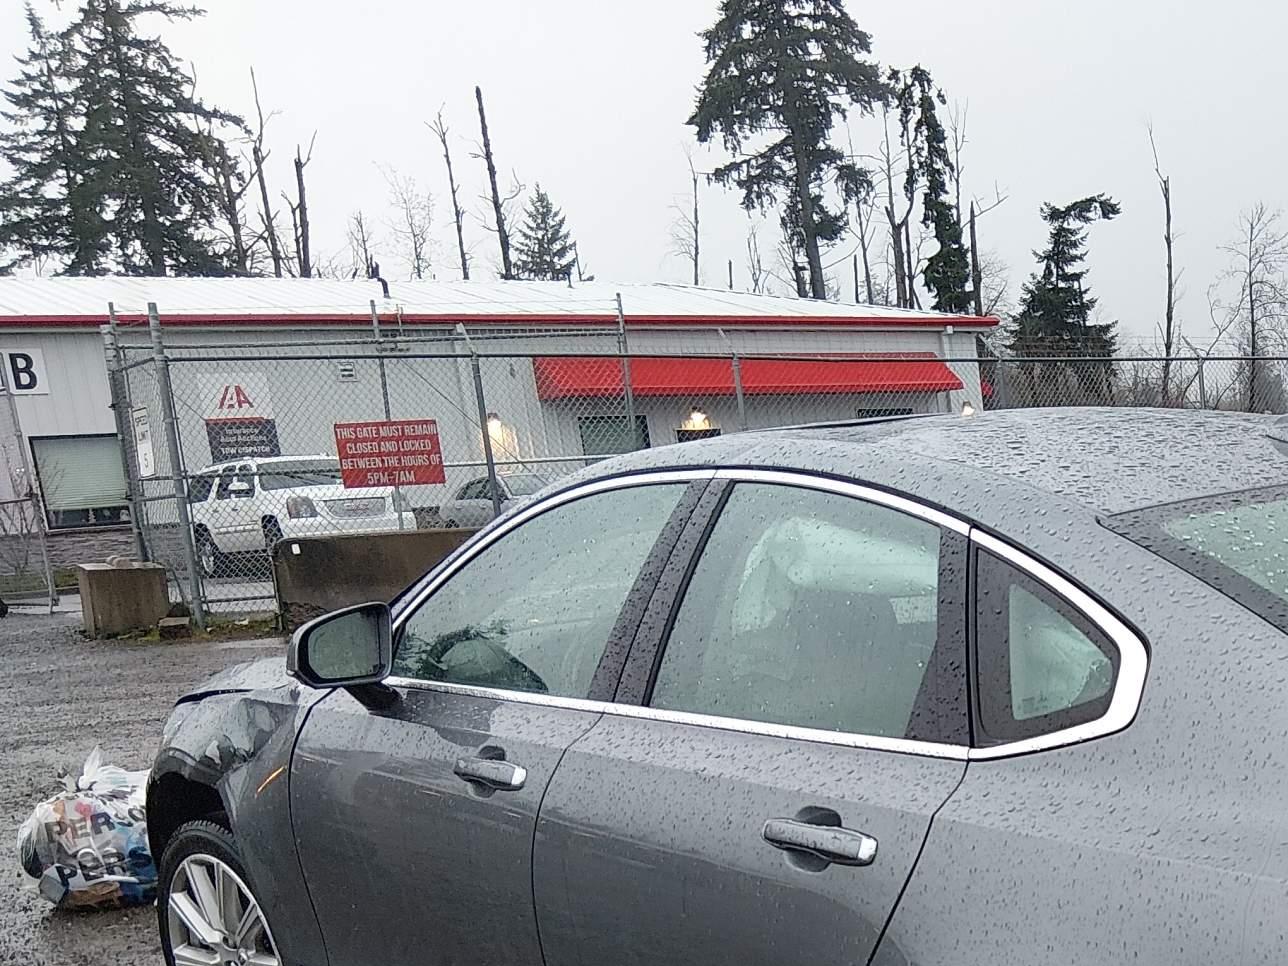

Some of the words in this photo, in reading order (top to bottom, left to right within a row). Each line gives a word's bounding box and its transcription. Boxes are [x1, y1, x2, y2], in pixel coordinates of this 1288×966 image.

[9, 353, 38, 390] B
[336, 428, 356, 439] THIS
[357, 426, 378, 438] GATE
[380, 425, 402, 437] MUST
[405, 423, 437, 436] REMAIN
[346, 441, 379, 454] CLOSED
[380, 440, 398, 453] AND
[400, 439, 432, 452] LOCKED
[342, 456, 382, 469] BETWEEN
[383, 455, 400, 468] THE
[401, 454, 429, 467] HOURS
[430, 453, 441, 465] OF
[367, 470, 416, 485] 5PM-7AM
